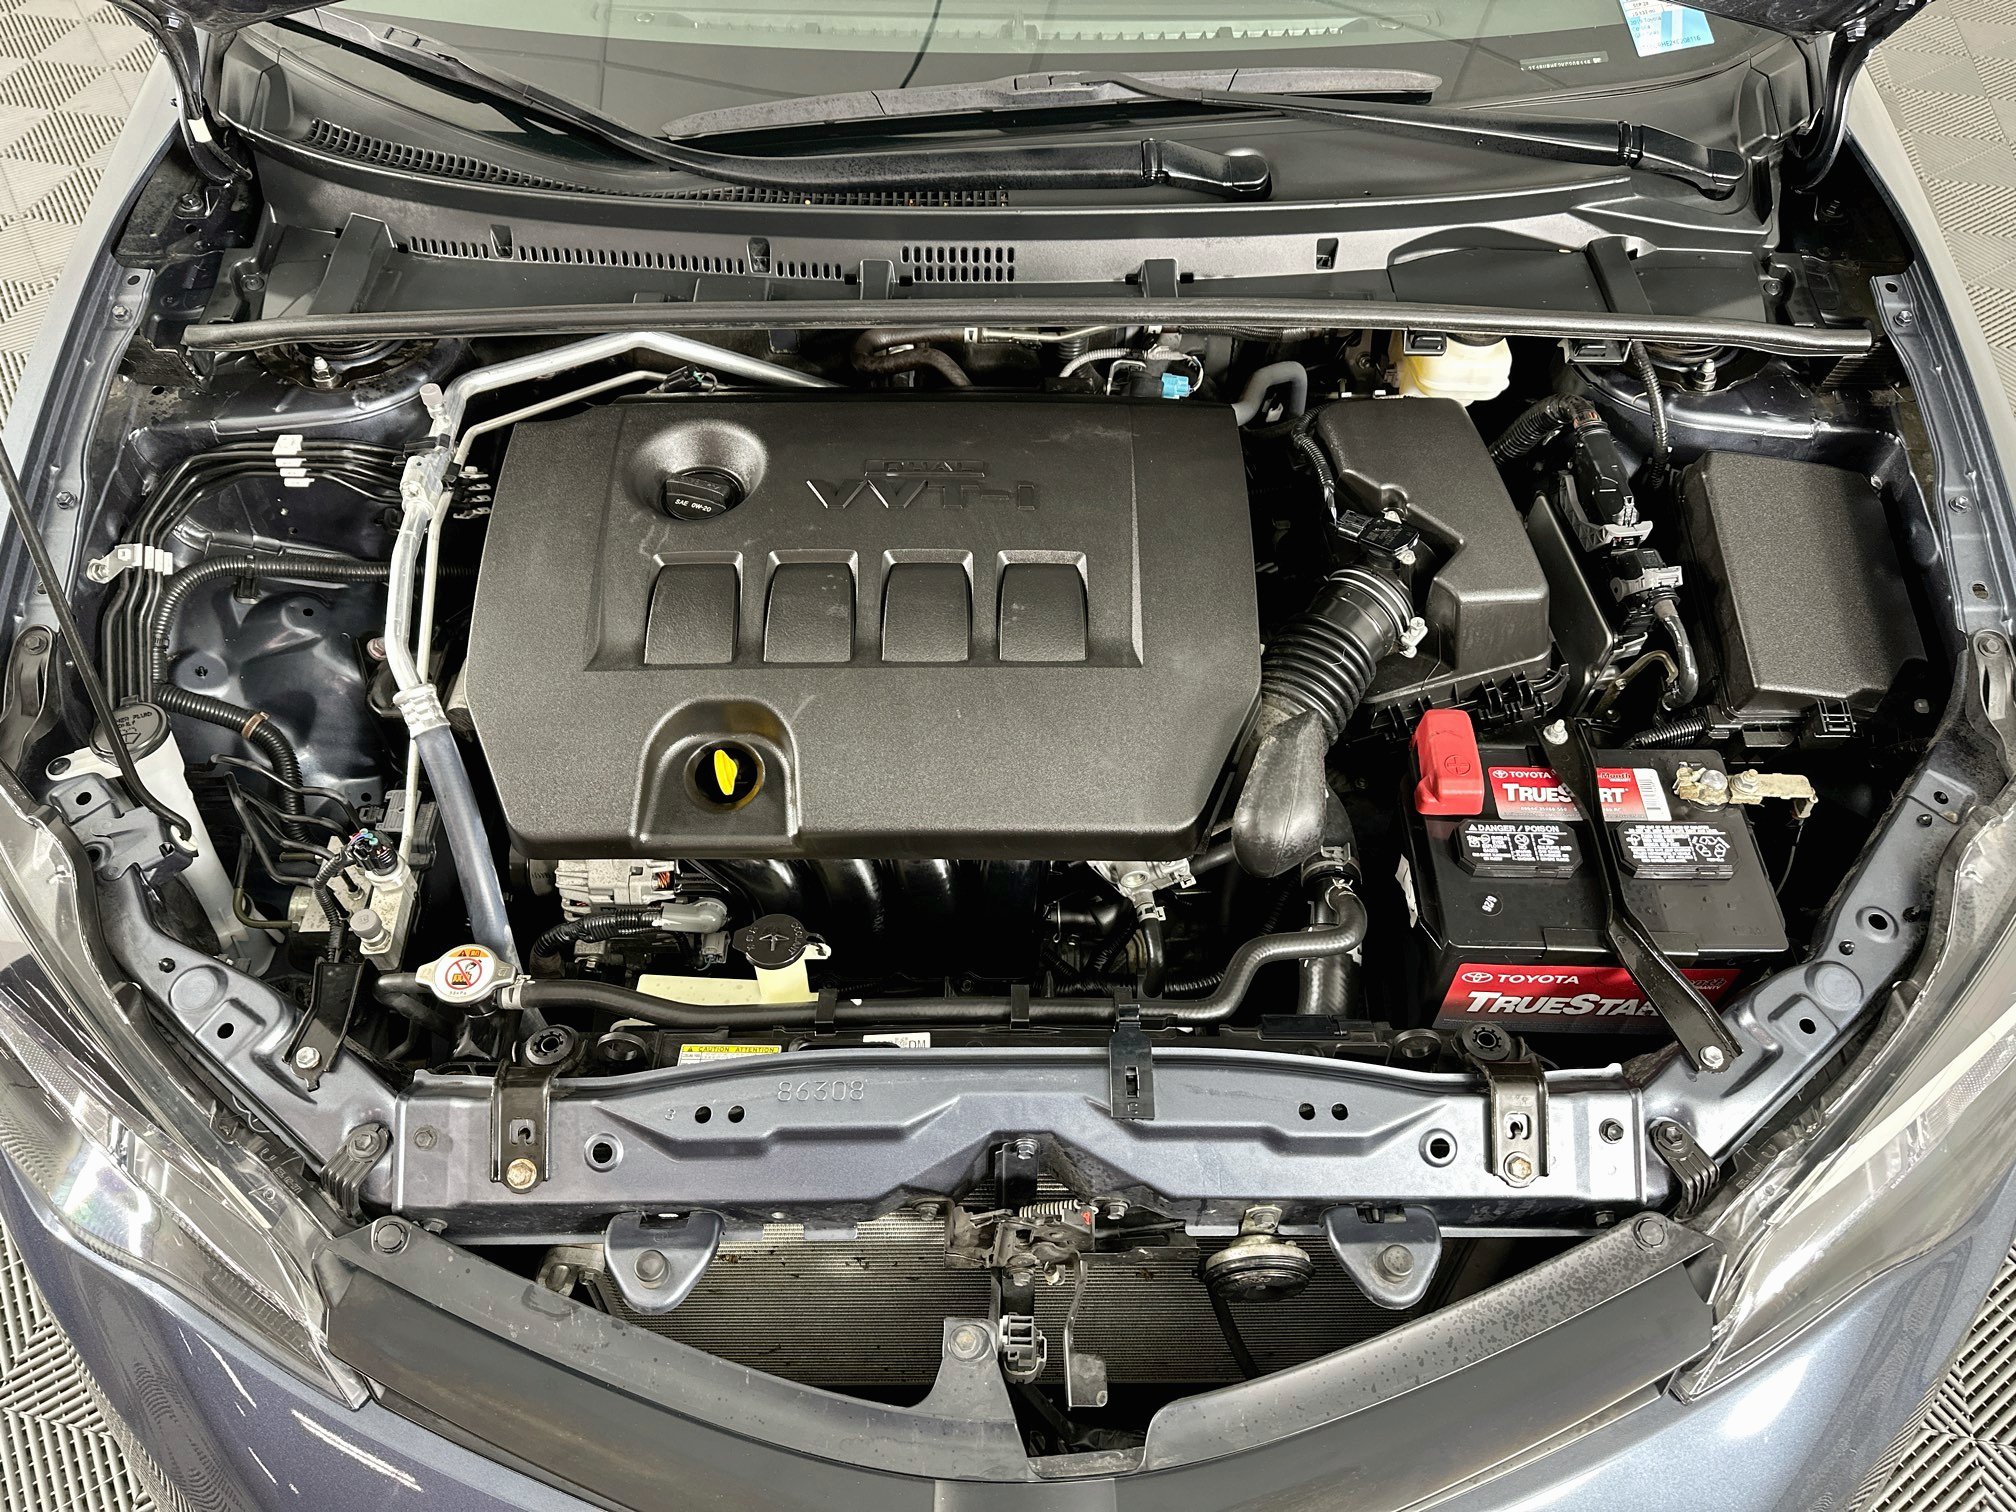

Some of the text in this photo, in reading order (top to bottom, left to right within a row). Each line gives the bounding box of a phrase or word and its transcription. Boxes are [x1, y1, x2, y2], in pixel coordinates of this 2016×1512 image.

[674, 498, 712, 513] SAE 0W-20
[132, 711, 153, 719] FLUID
[1508, 771, 1552, 779] TOYOTA
[1477, 824, 1516, 832] DANGER
[1524, 825, 1560, 833] POISON
[1497, 974, 1579, 985] TOYOTA
[698, 1045, 775, 1054] CAUTION ATTENTION
[776, 1080, 865, 1102] 86308
